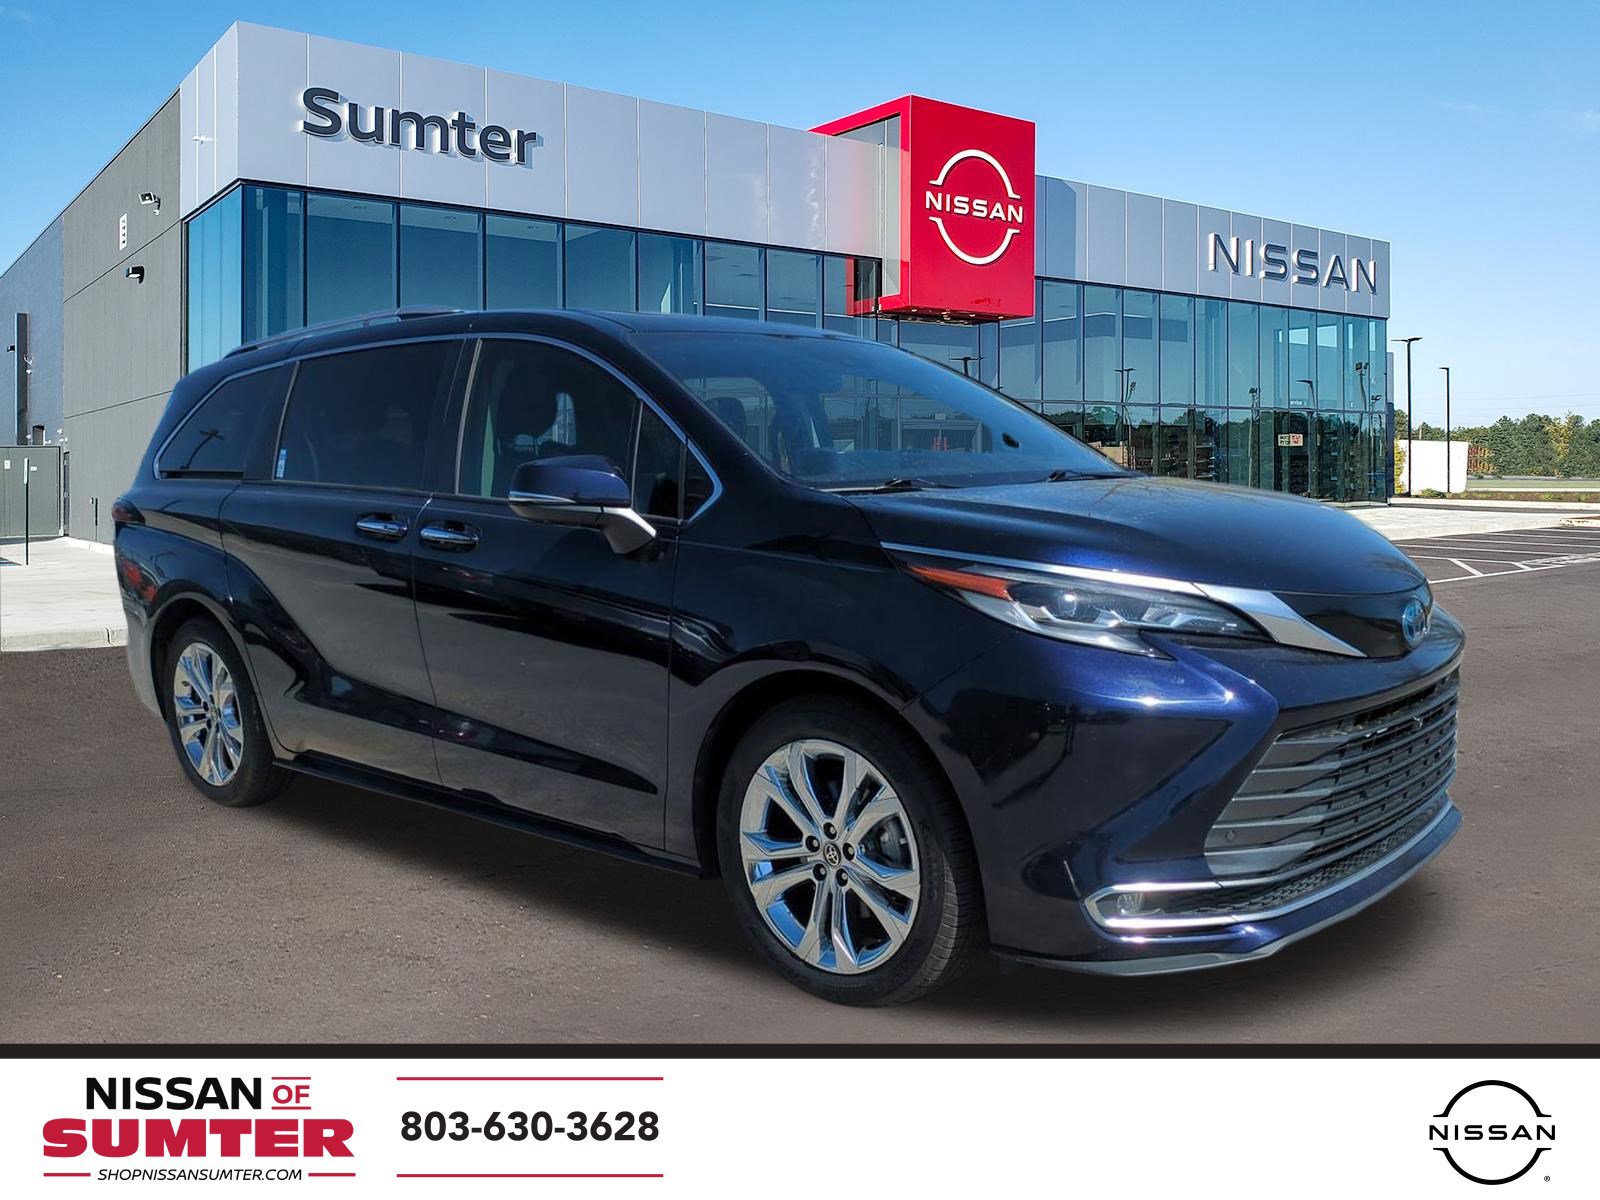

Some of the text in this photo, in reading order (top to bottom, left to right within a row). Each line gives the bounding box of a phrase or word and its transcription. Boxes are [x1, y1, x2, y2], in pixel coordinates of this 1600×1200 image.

[301, 86, 537, 165] Sumter
[925, 190, 1024, 224] NISSAN
[1208, 232, 1378, 295] NISSAN
